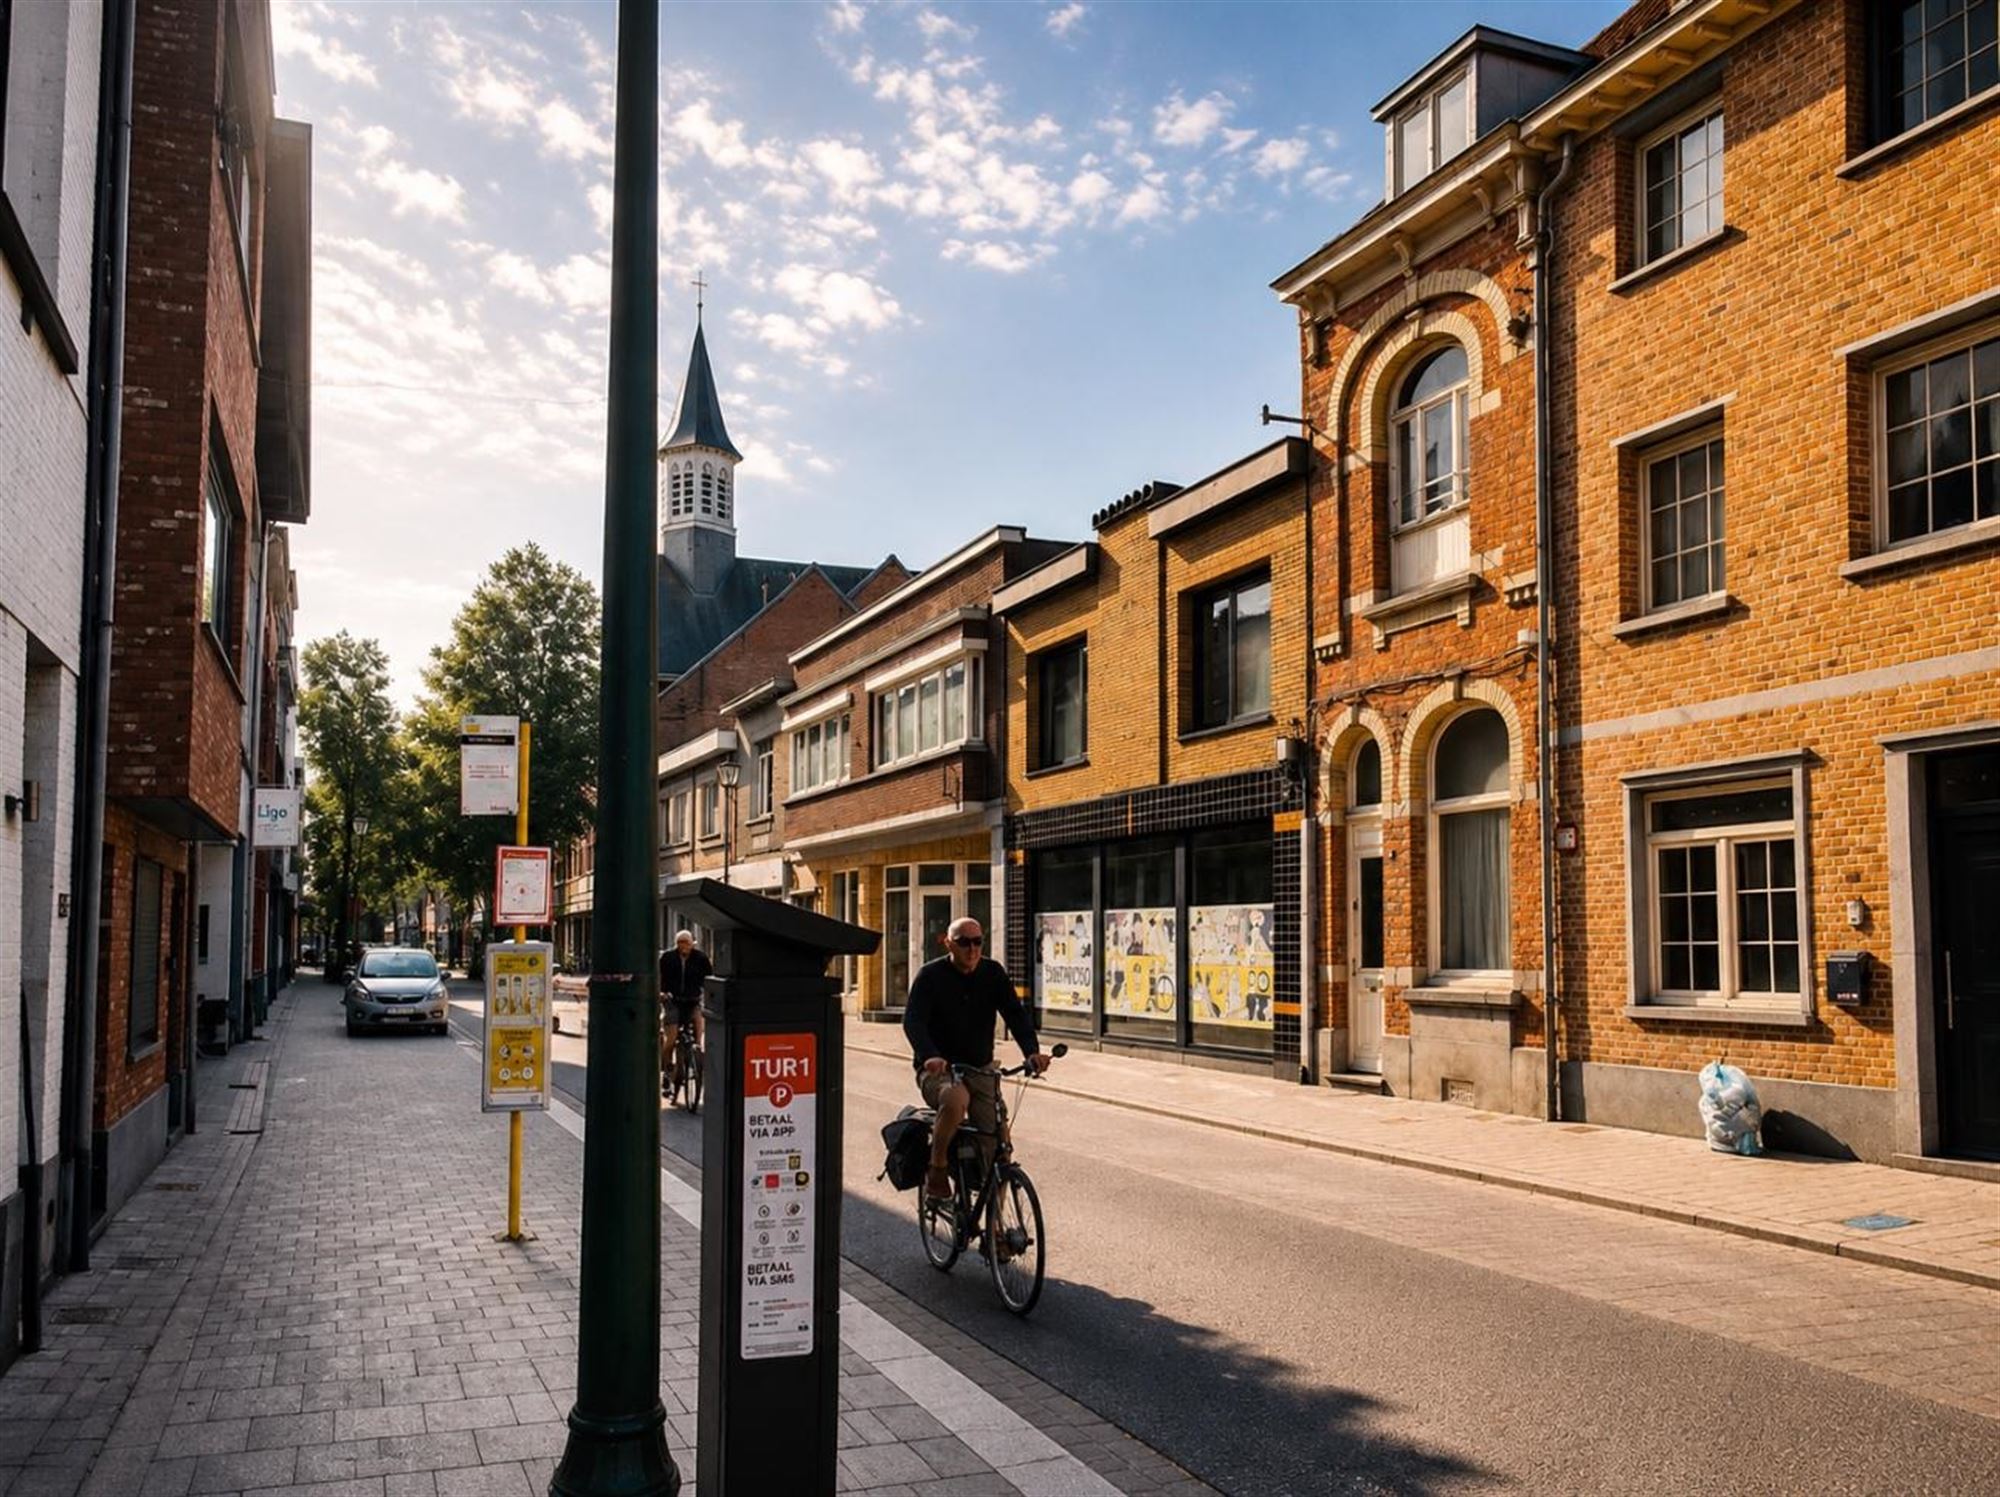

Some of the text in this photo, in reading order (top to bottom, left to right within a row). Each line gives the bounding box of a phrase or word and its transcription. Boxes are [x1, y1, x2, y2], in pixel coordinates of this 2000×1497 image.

[258, 804, 288, 822] Ligo
[750, 1057, 809, 1079] TUR1
[776, 1088, 787, 1103] P
[749, 1114, 793, 1126] BETAAL
[750, 1126, 796, 1139] VIA APP
[748, 1261, 792, 1275] BETAAL
[747, 1274, 795, 1286] VIA SMS
